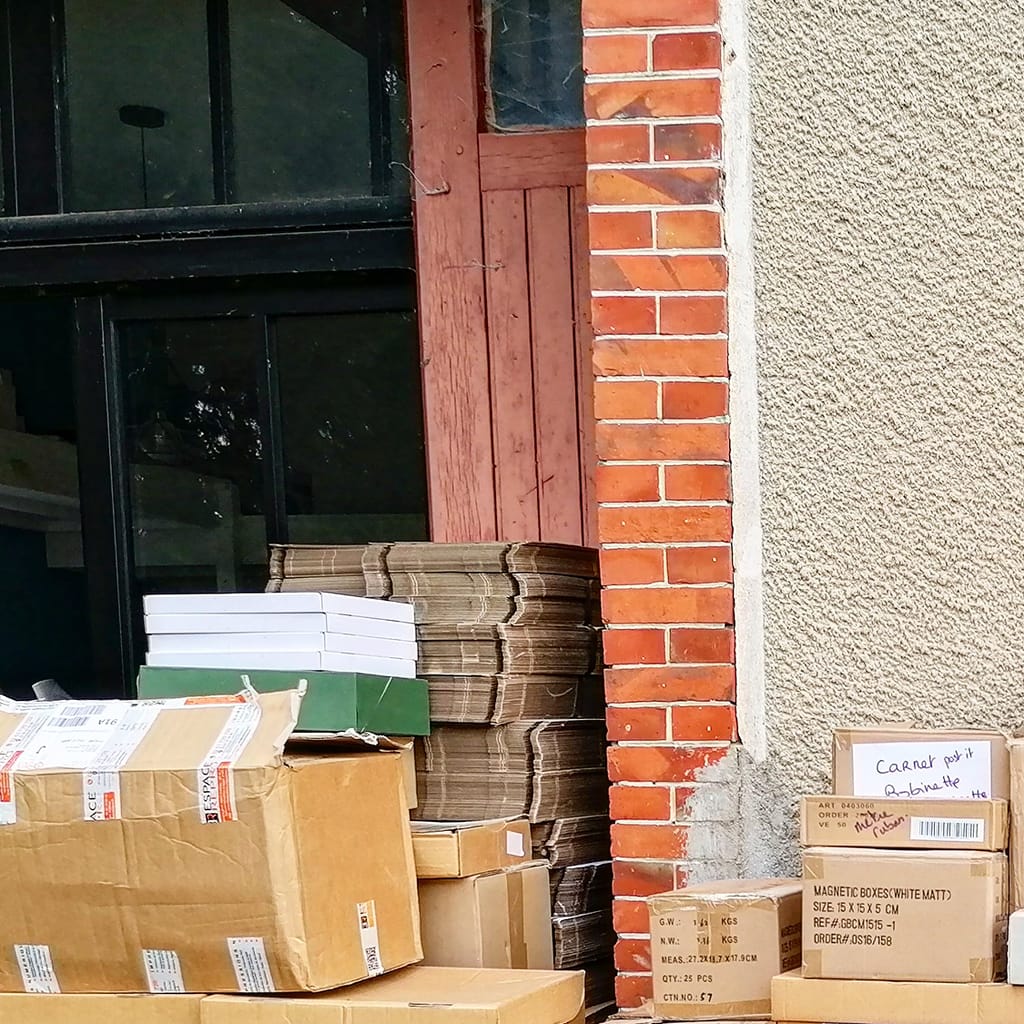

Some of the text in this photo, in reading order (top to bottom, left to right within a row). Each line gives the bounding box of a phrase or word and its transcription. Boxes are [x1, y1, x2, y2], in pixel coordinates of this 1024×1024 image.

[818, 811, 849, 819] ORDER
[813, 885, 952, 901] MAGNETIC BOXES(WHITE MATT)
[813, 901, 899, 915] SIZE: 15 X 15 X 5 CM
[721, 917, 738, 926] KGS
[721, 936, 738, 945] KGS
[684, 975, 693, 983] 25
[697, 975, 713, 983] PCS
